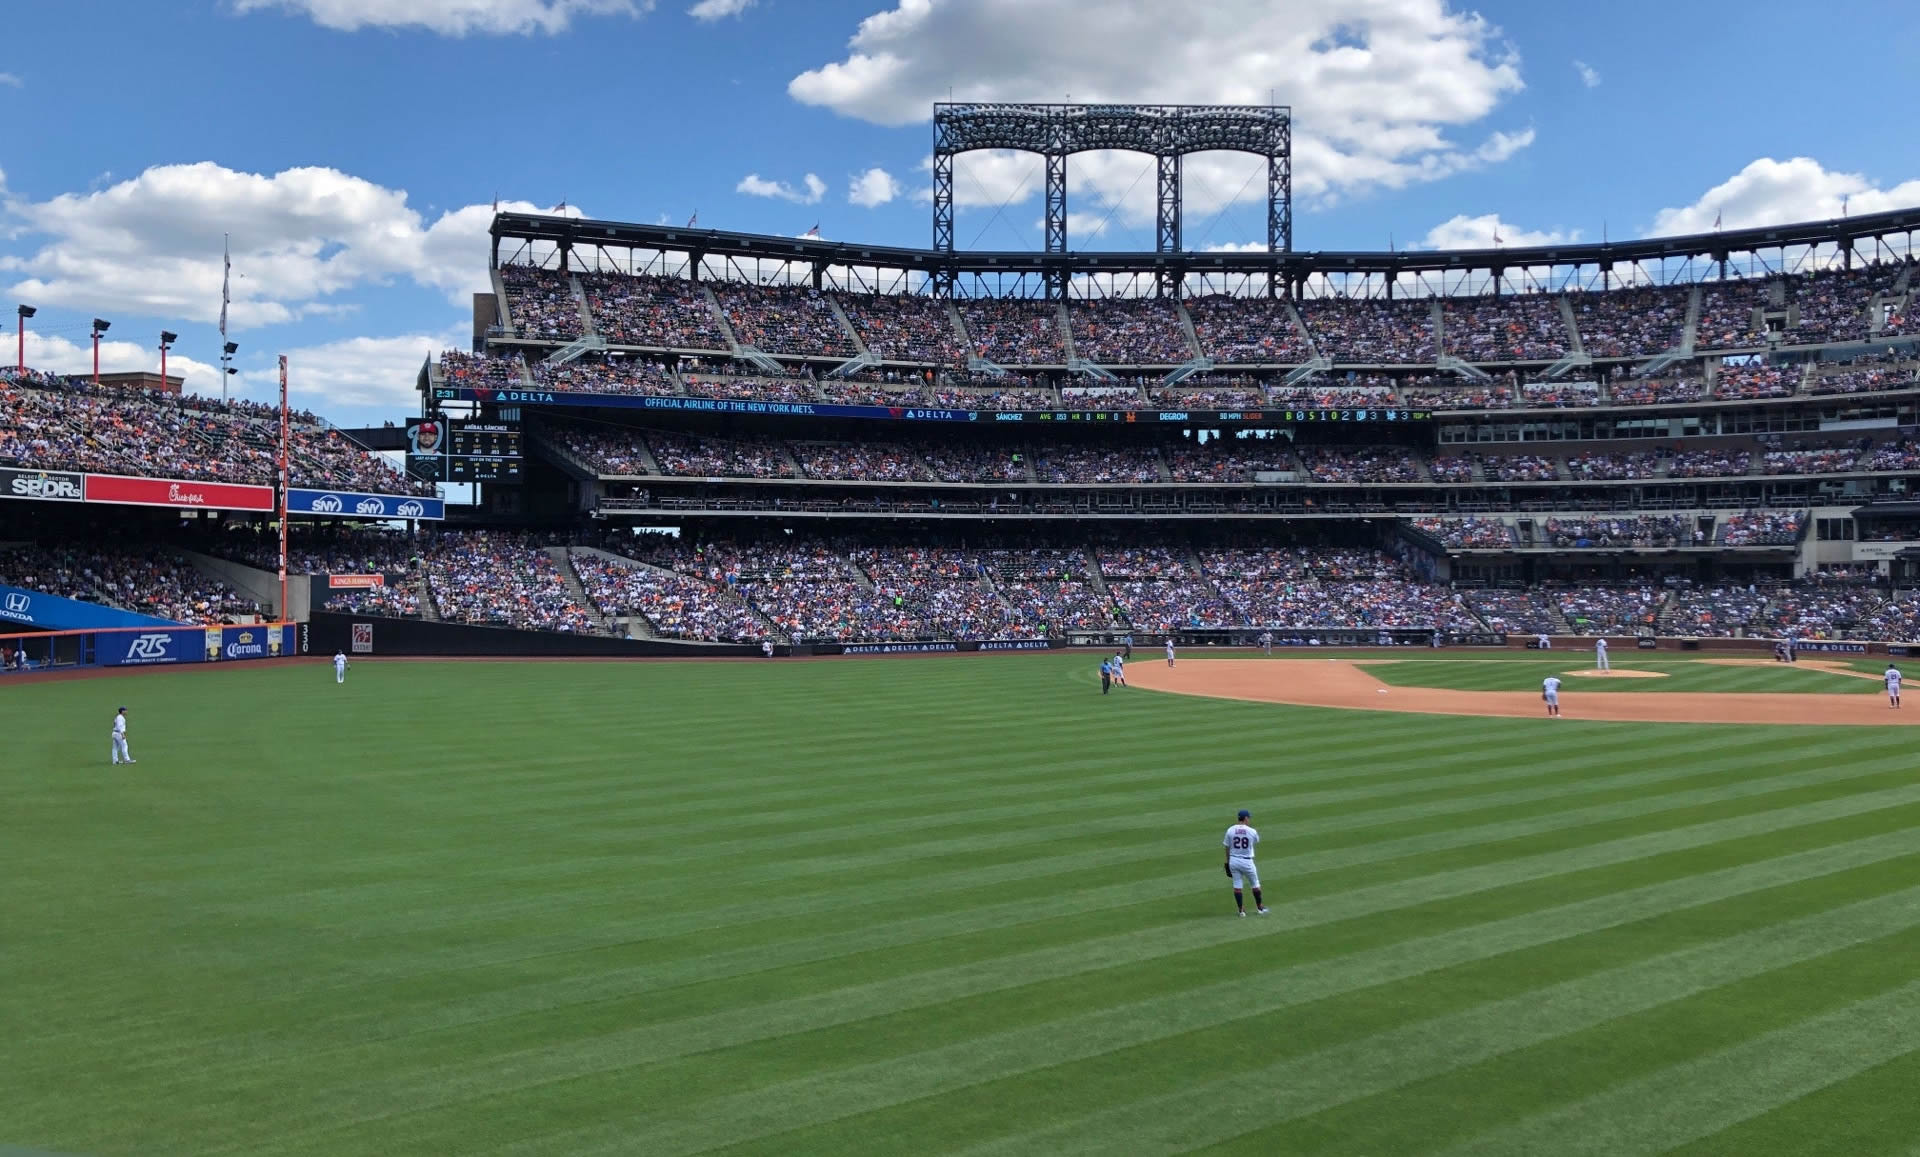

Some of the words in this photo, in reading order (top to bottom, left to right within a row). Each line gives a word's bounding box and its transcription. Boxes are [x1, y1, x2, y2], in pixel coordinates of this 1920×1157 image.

[436, 390, 454, 398] 2:31
[510, 392, 553, 401] DELTA
[645, 398, 681, 408] OFFICIAL
[684, 400, 715, 409] AIRLINE
[717, 401, 728, 410] OF
[730, 402, 746, 411] THE
[747, 403, 766, 412] NEW
[767, 404, 790, 413] YORK
[791, 405, 815, 414] METS.
[917, 410, 952, 419] DELTA
[996, 411, 1023, 421] SÁNCHEZ
[1160, 412, 1188, 420] DEGROM
[1285, 412, 1292, 421] B
[1308, 411, 1315, 421] S
[1320, 411, 1326, 421] 1
[1341, 411, 1349, 421] 2
[1370, 411, 1377, 420] 3
[1401, 411, 1409, 420] 3
[312, 498, 340, 512] SNY
[356, 500, 382, 514] SNY
[397, 503, 421, 516] SNY
[0, 610, 33, 622] ONDA
[127, 634, 172, 658] RTS
[227, 642, 262, 658] Corona
[1233, 836, 1250, 850] 28
